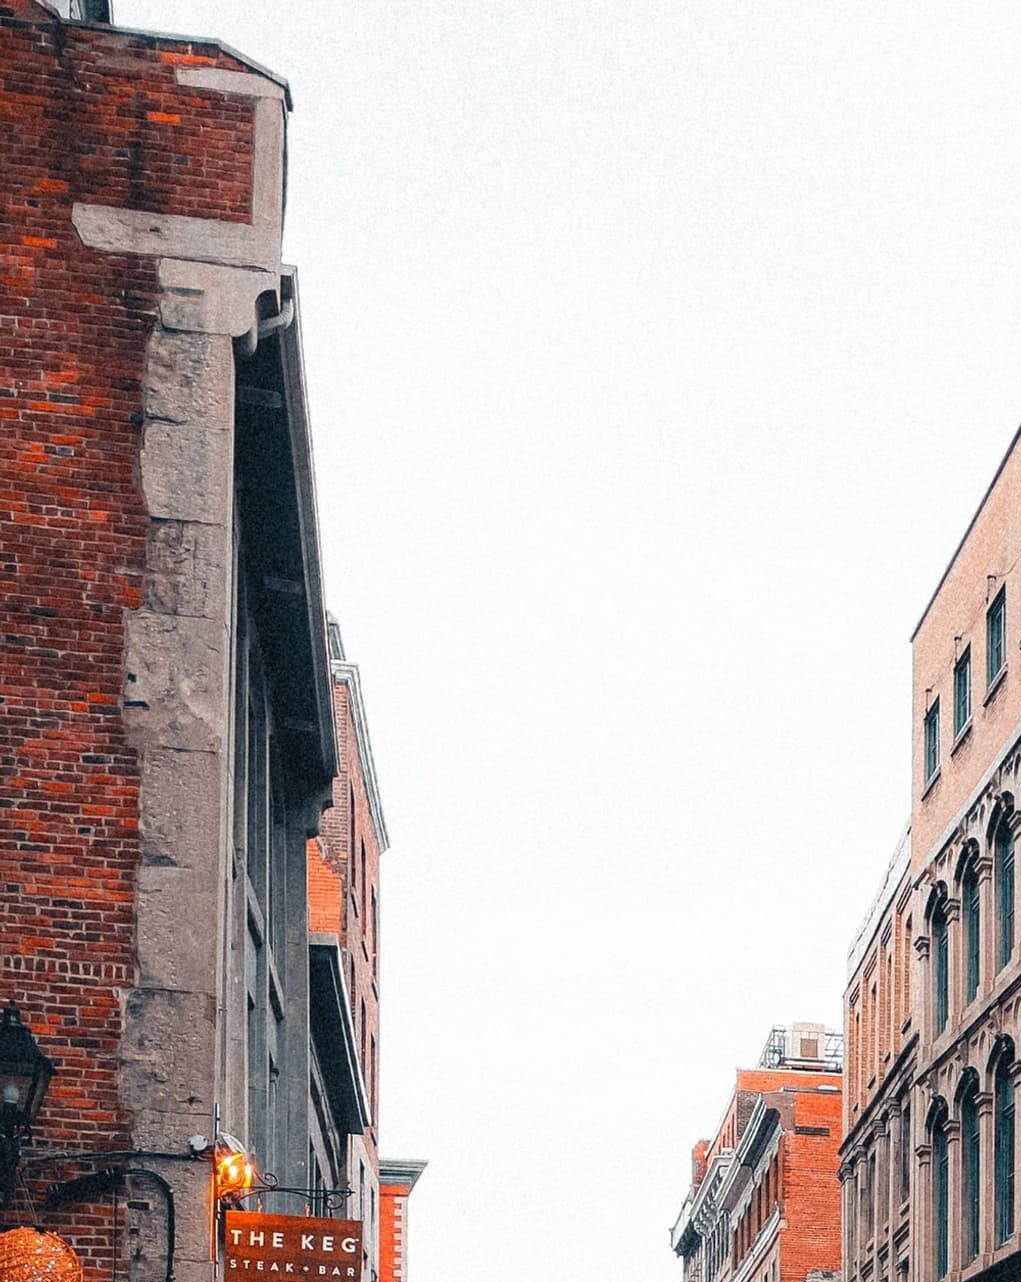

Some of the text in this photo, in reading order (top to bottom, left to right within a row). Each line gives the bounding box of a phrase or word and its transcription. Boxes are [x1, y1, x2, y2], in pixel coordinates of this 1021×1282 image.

[230, 1229, 357, 1253] THE KEG
[229, 1259, 294, 1273] STEAK
[318, 1265, 355, 1277] BAR
